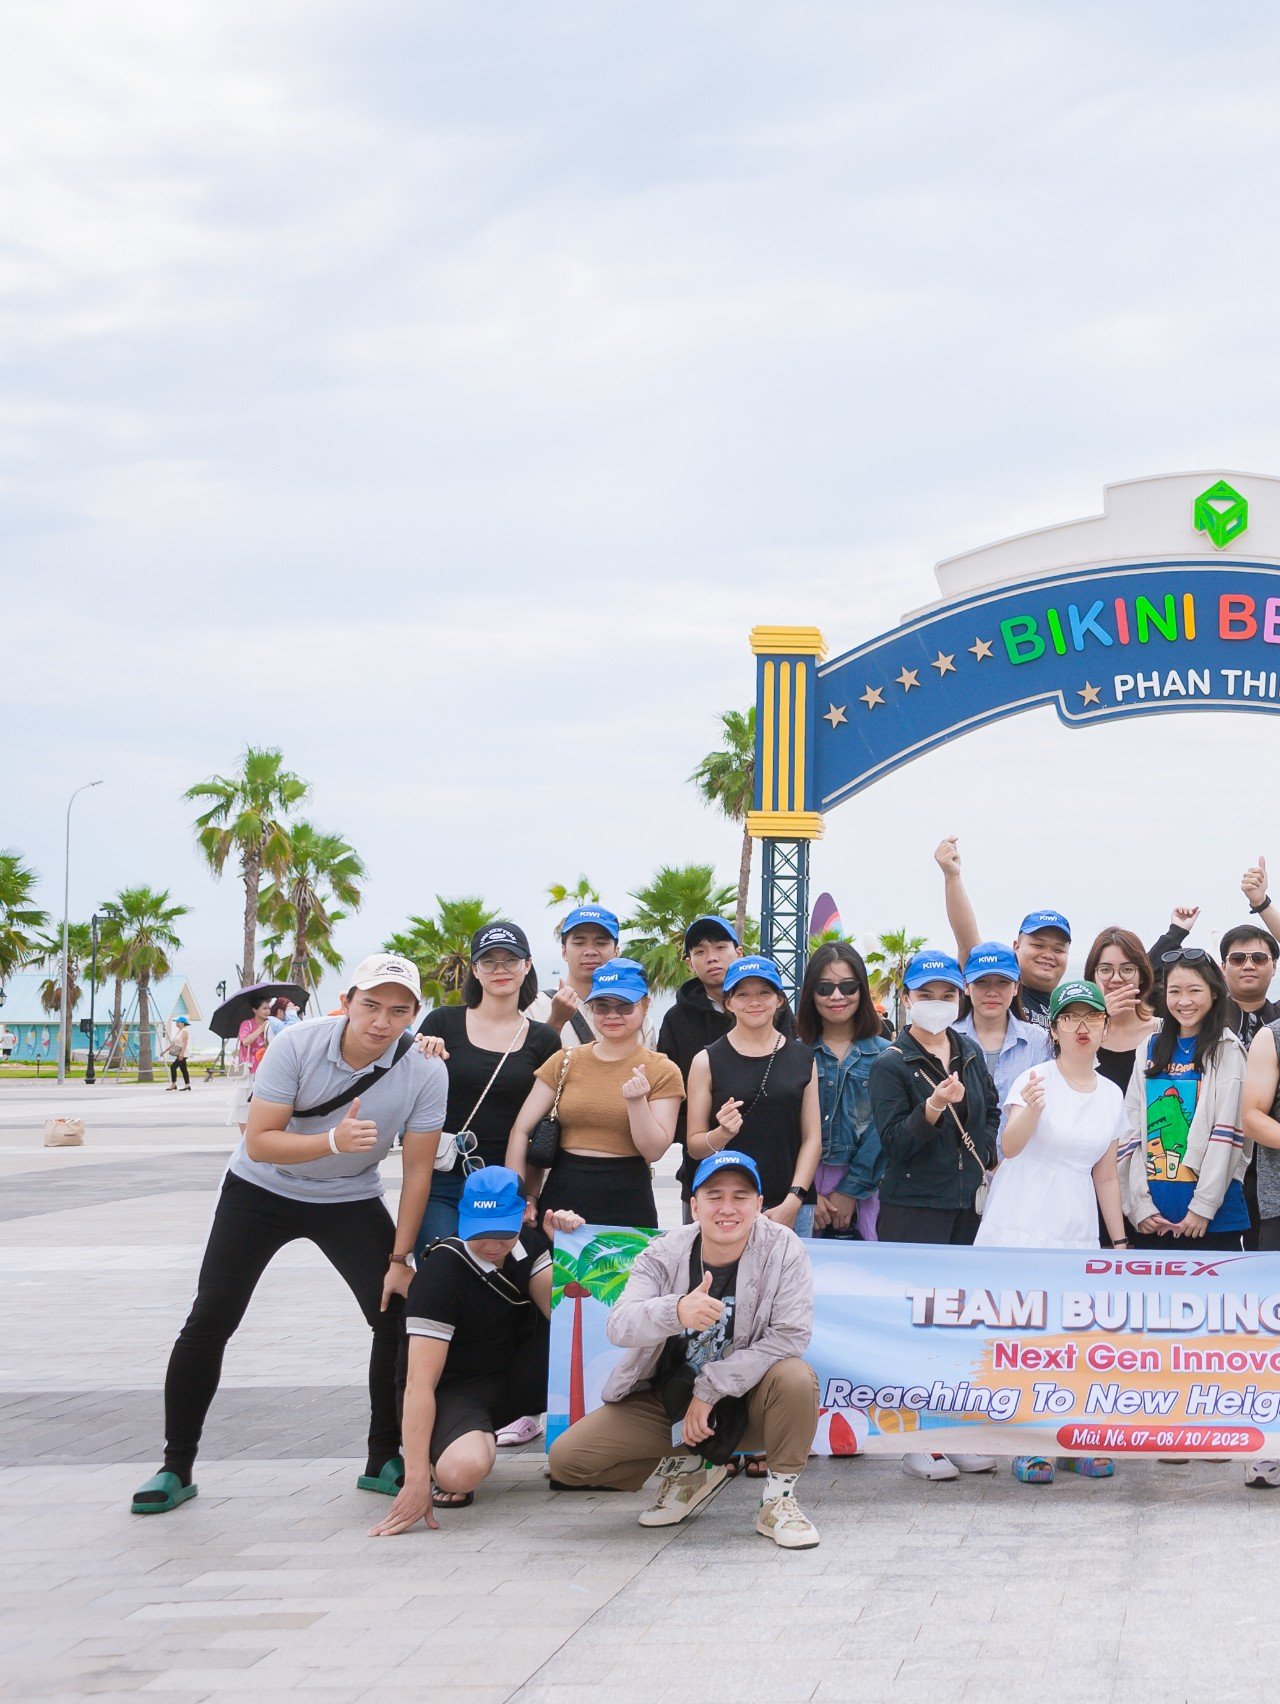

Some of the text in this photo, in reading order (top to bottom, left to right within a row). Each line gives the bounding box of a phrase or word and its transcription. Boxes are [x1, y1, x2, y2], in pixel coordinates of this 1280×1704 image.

[1000, 592, 1196, 665] BIKINI
[1114, 668, 1210, 701] PHAN
[739, 963, 760, 972] KIWI
[922, 961, 944, 970] KIWI
[598, 973, 619, 982] KIWI
[714, 1156, 740, 1164] KIWI
[473, 1200, 497, 1209] KIWI
[905, 1287, 1047, 1329] TEAM
[994, 1342, 1077, 1371] Next
[1087, 1343, 1162, 1372] Gen
[824, 1378, 1021, 1422] Reaching
[1033, 1383, 1076, 1413] To
[1085, 1383, 1179, 1416] New
